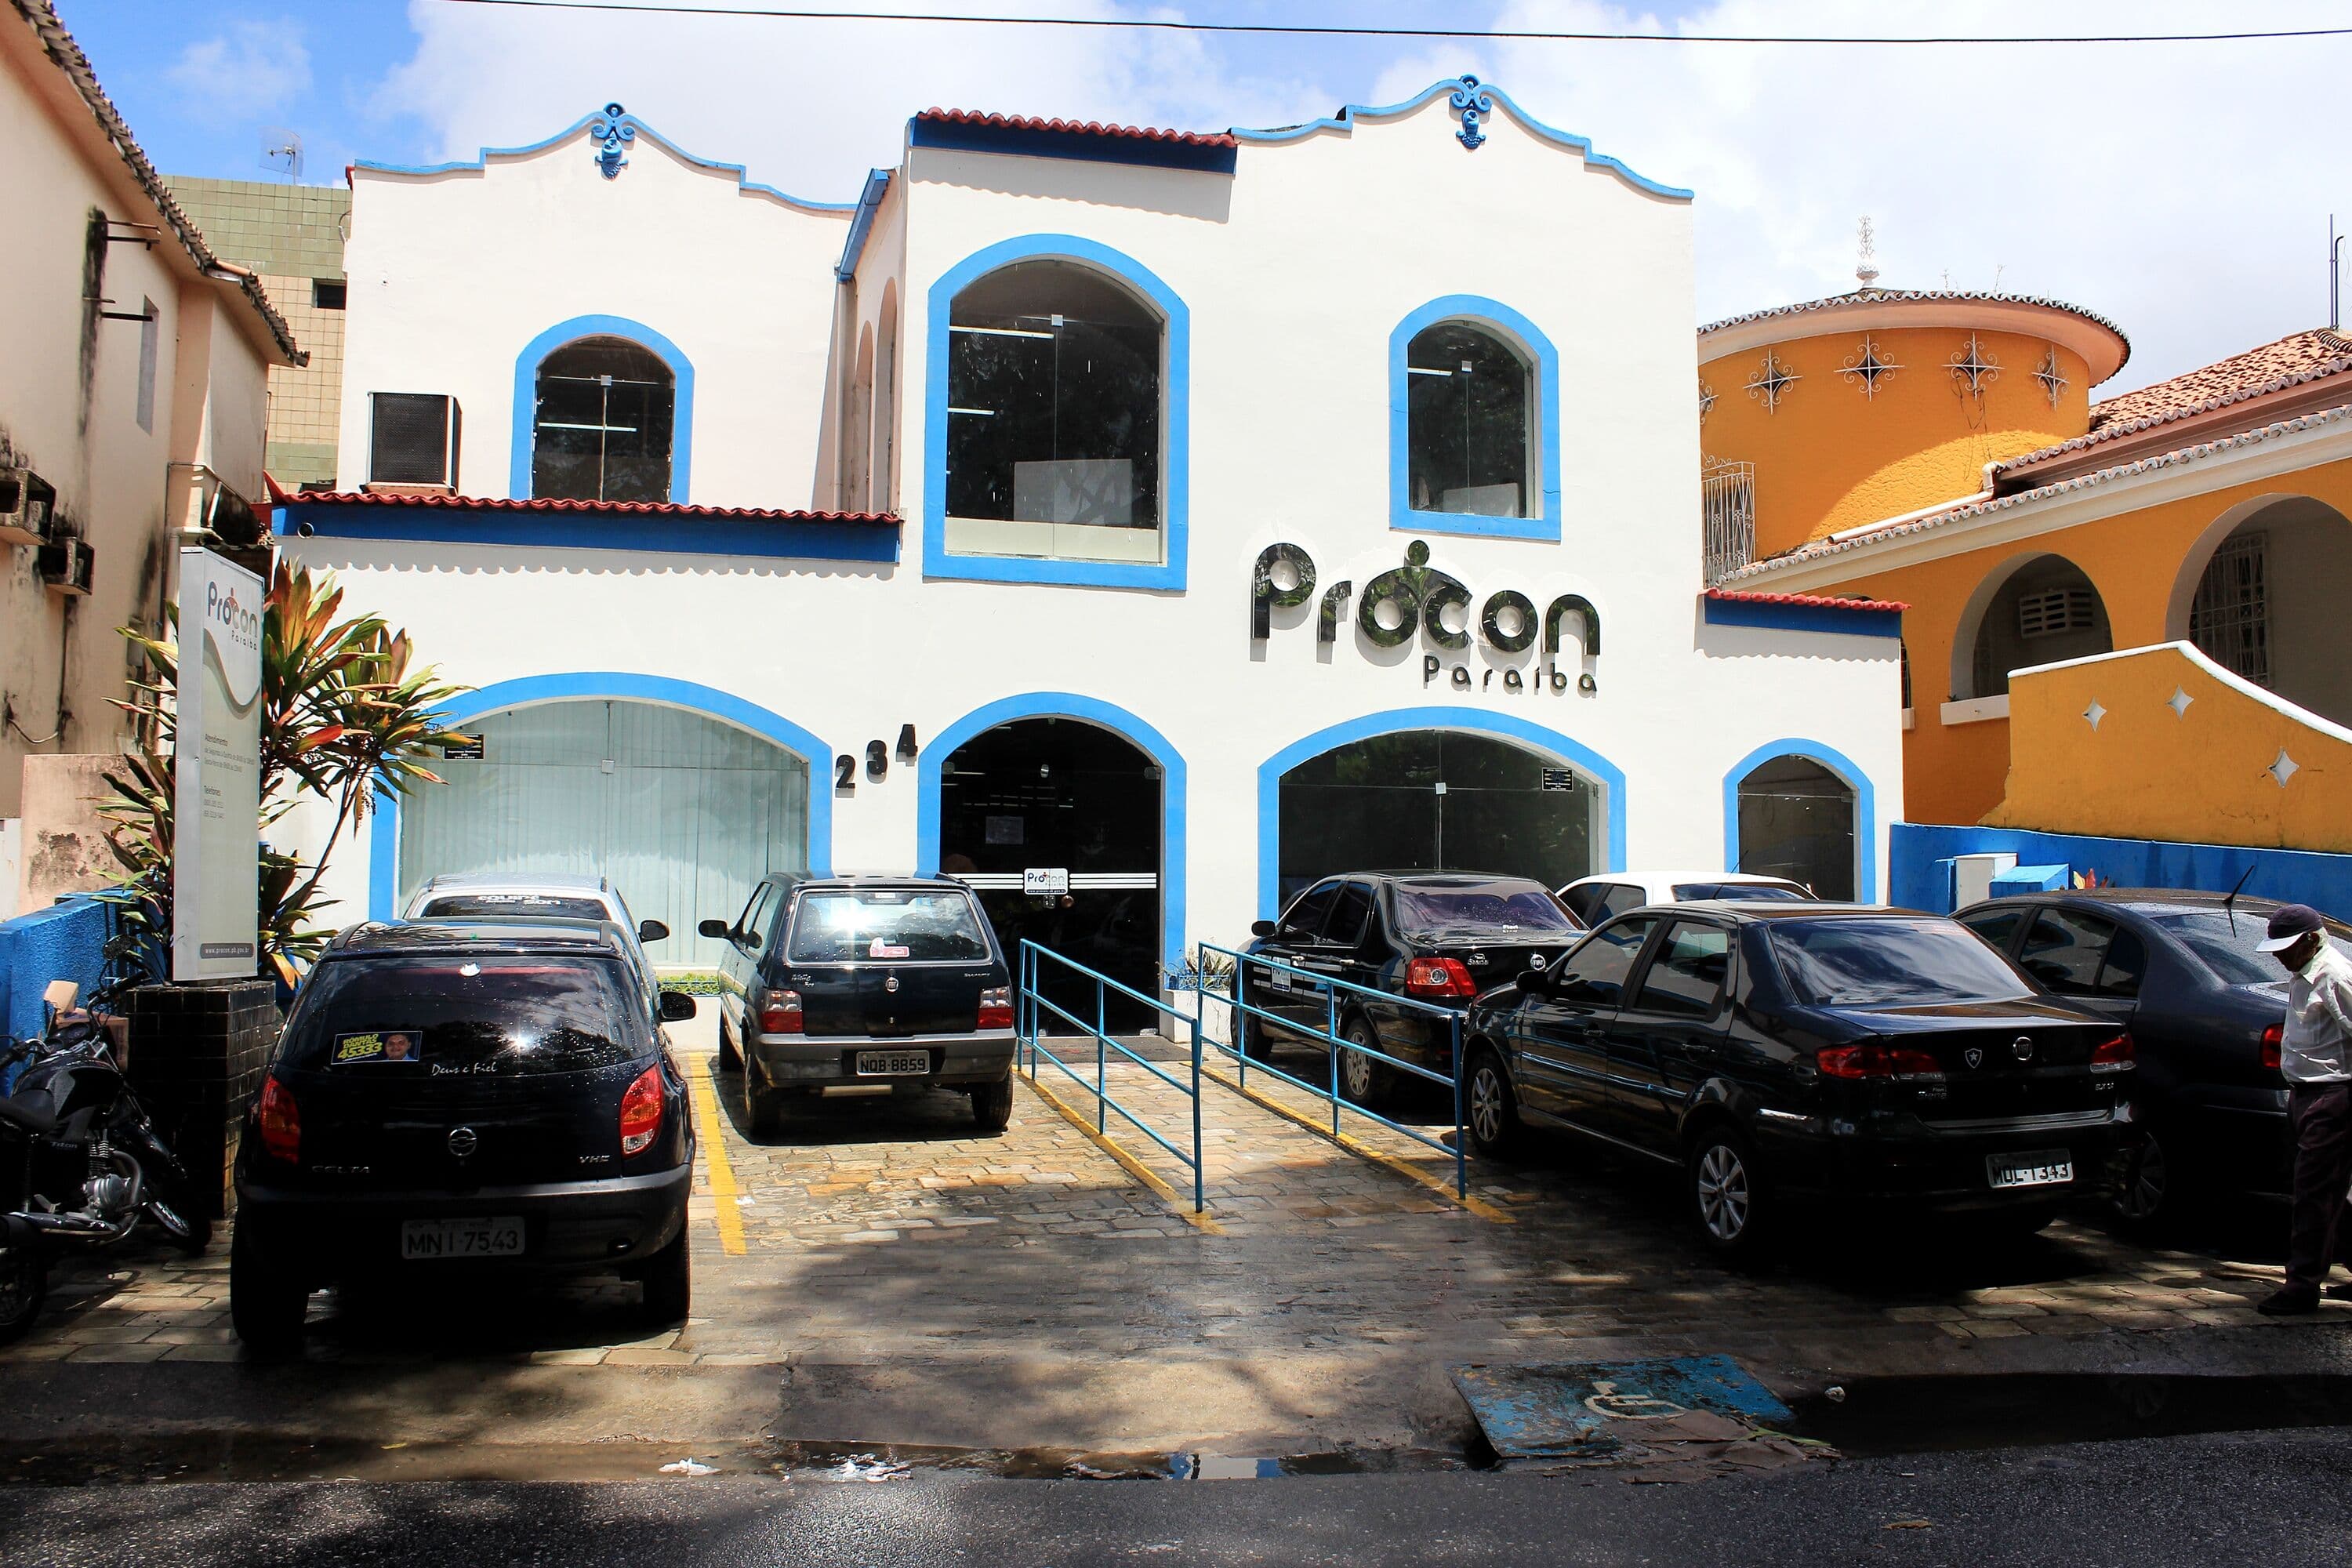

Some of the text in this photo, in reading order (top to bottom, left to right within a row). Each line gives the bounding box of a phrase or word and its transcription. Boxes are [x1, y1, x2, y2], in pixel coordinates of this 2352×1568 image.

[208, 581, 258, 638] Procon
[1248, 541, 1600, 655] Procon
[1423, 655, 1598, 691] Paraíba
[338, 1042, 383, 1059] 45333
[431, 1063, 460, 1076] Deus
